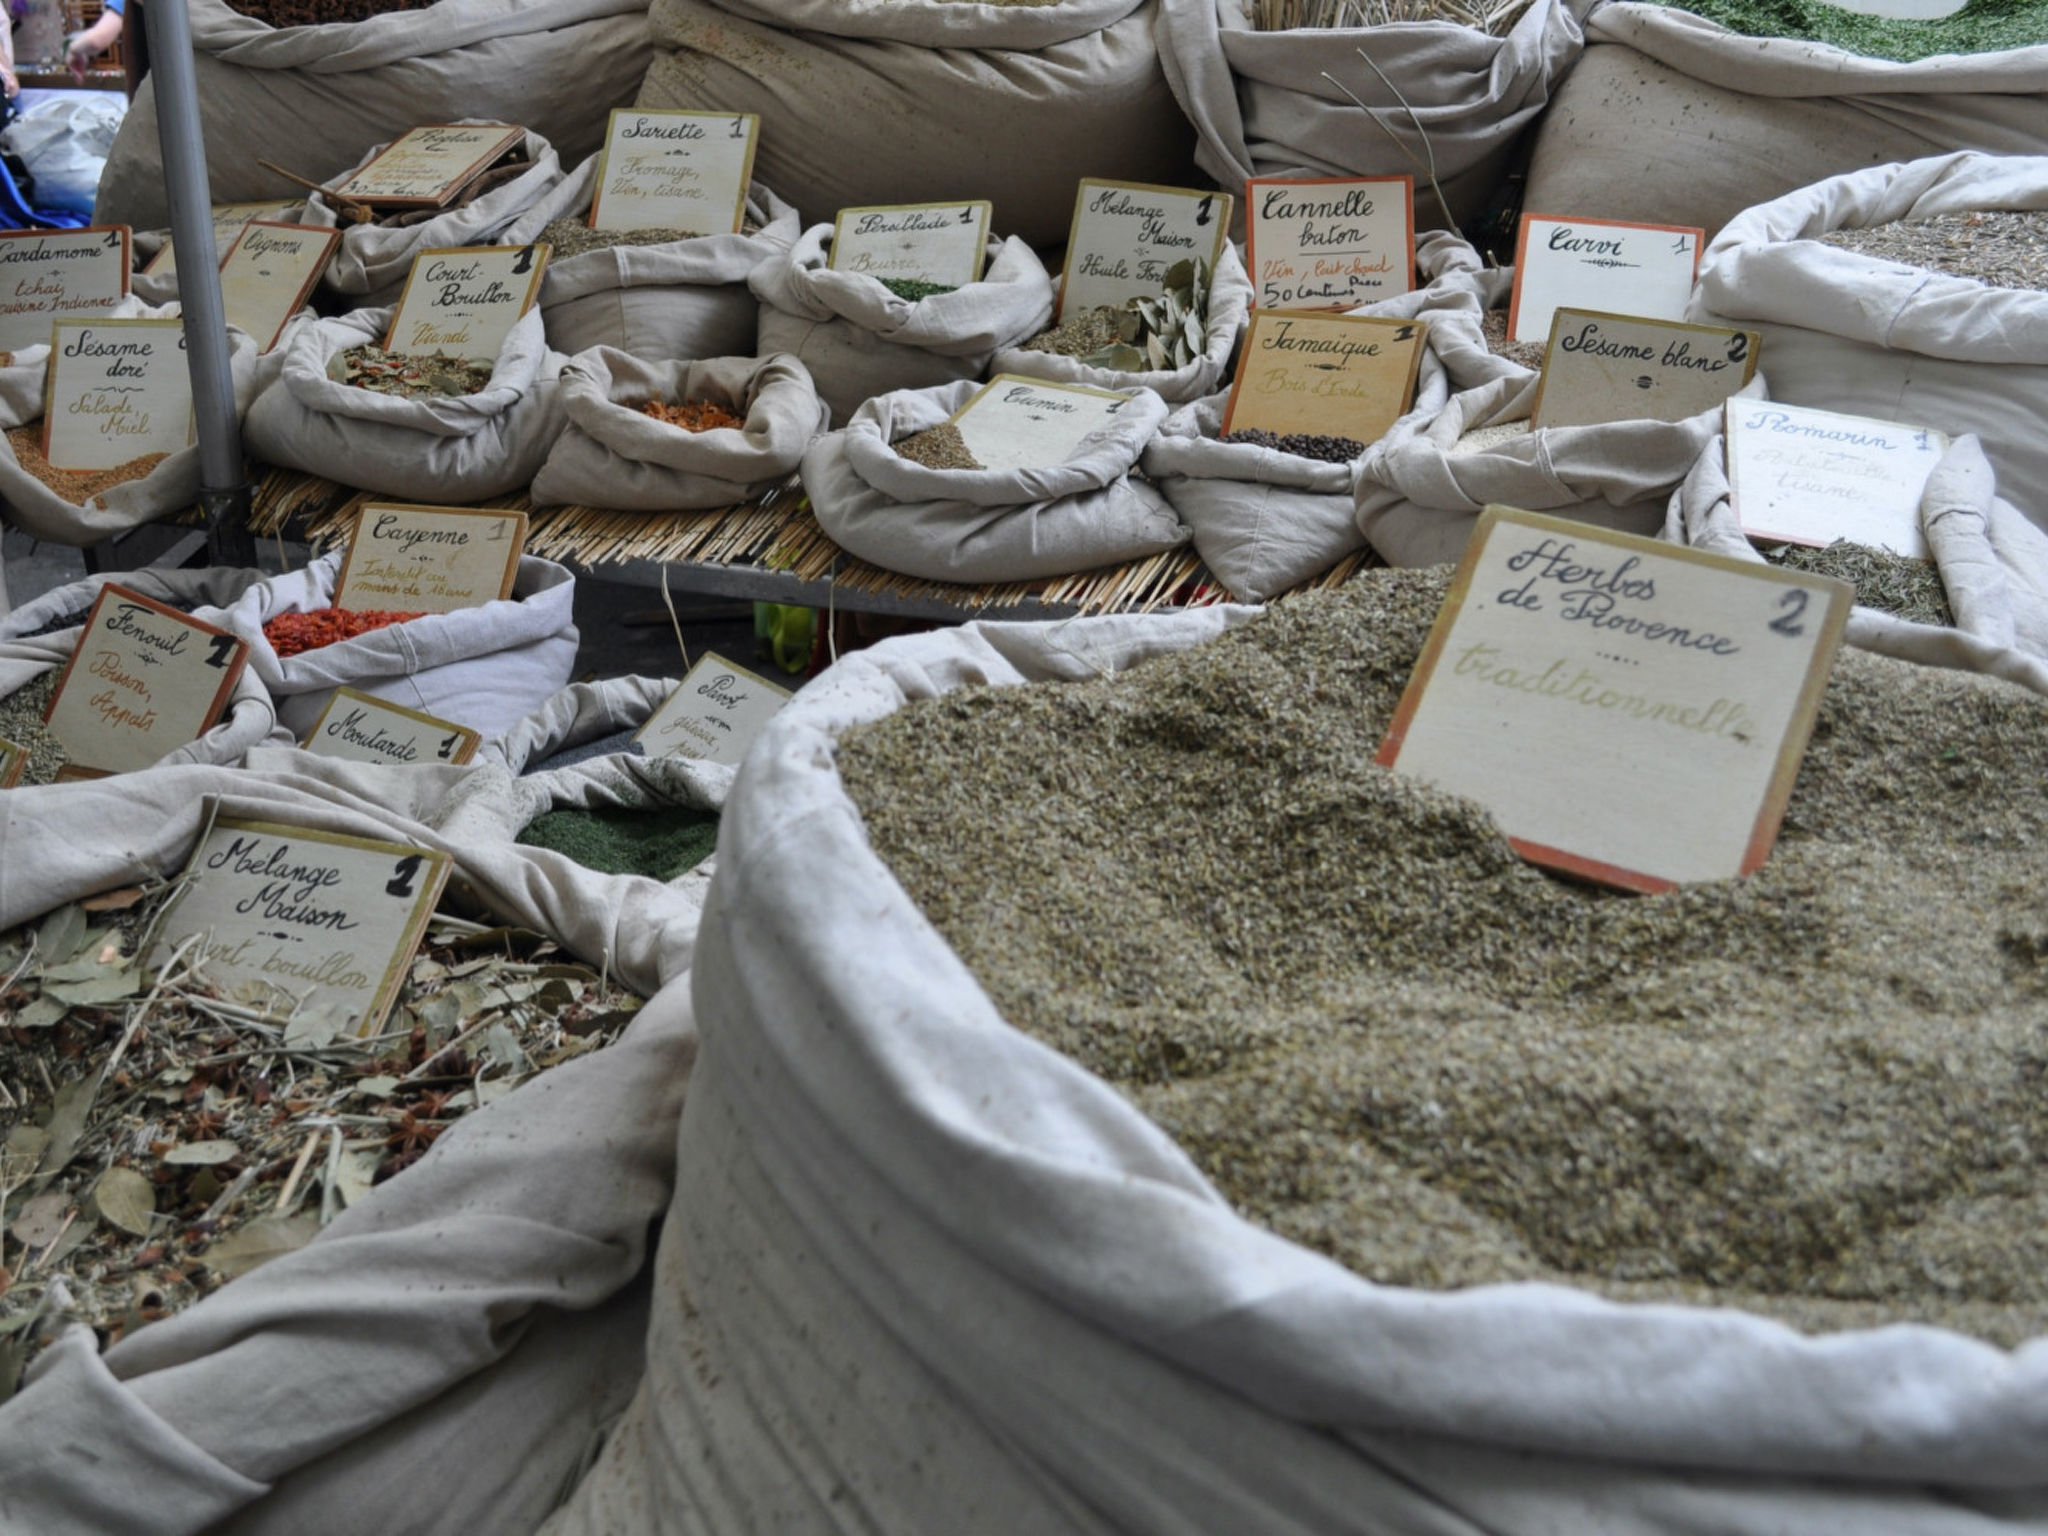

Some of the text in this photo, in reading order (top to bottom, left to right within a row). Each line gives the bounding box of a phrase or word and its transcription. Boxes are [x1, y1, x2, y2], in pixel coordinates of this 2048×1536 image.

[729, 115, 743, 138] 1
[958, 206, 974, 224] 1
[1262, 190, 1374, 219] Cannelle
[0, 229, 120, 263] Cardamome 1
[1138, 220, 1197, 249] Maison
[1299, 221, 1368, 246] baton
[1548, 226, 1693, 255] Carvi 1
[511, 245, 535, 275] 1
[1079, 253, 1129, 279] Huile
[1314, 259, 1344, 276] lait
[1344, 254, 1394, 275] chaud
[431, 281, 516, 306] Bouillon
[1264, 283, 1292, 304] 50
[64, 329, 154, 357] Sésame
[1262, 322, 1417, 365] Jamaïque 1
[1661, 341, 1729, 372] blanc
[1726, 332, 1748, 363] 2
[106, 357, 149, 378] doré
[1003, 386, 1078, 413] Cumin
[1745, 411, 1930, 451] Romarin 1
[372, 513, 507, 553] Cayenne 1
[402, 582, 421, 596] de
[1507, 538, 1810, 638] Herbes 2
[1497, 577, 1743, 656] de Provence
[106, 604, 237, 669] Fenouil 1
[328, 708, 460, 761] Moutarde 1
[207, 837, 342, 902] Mélange
[236, 882, 359, 930] Maison
